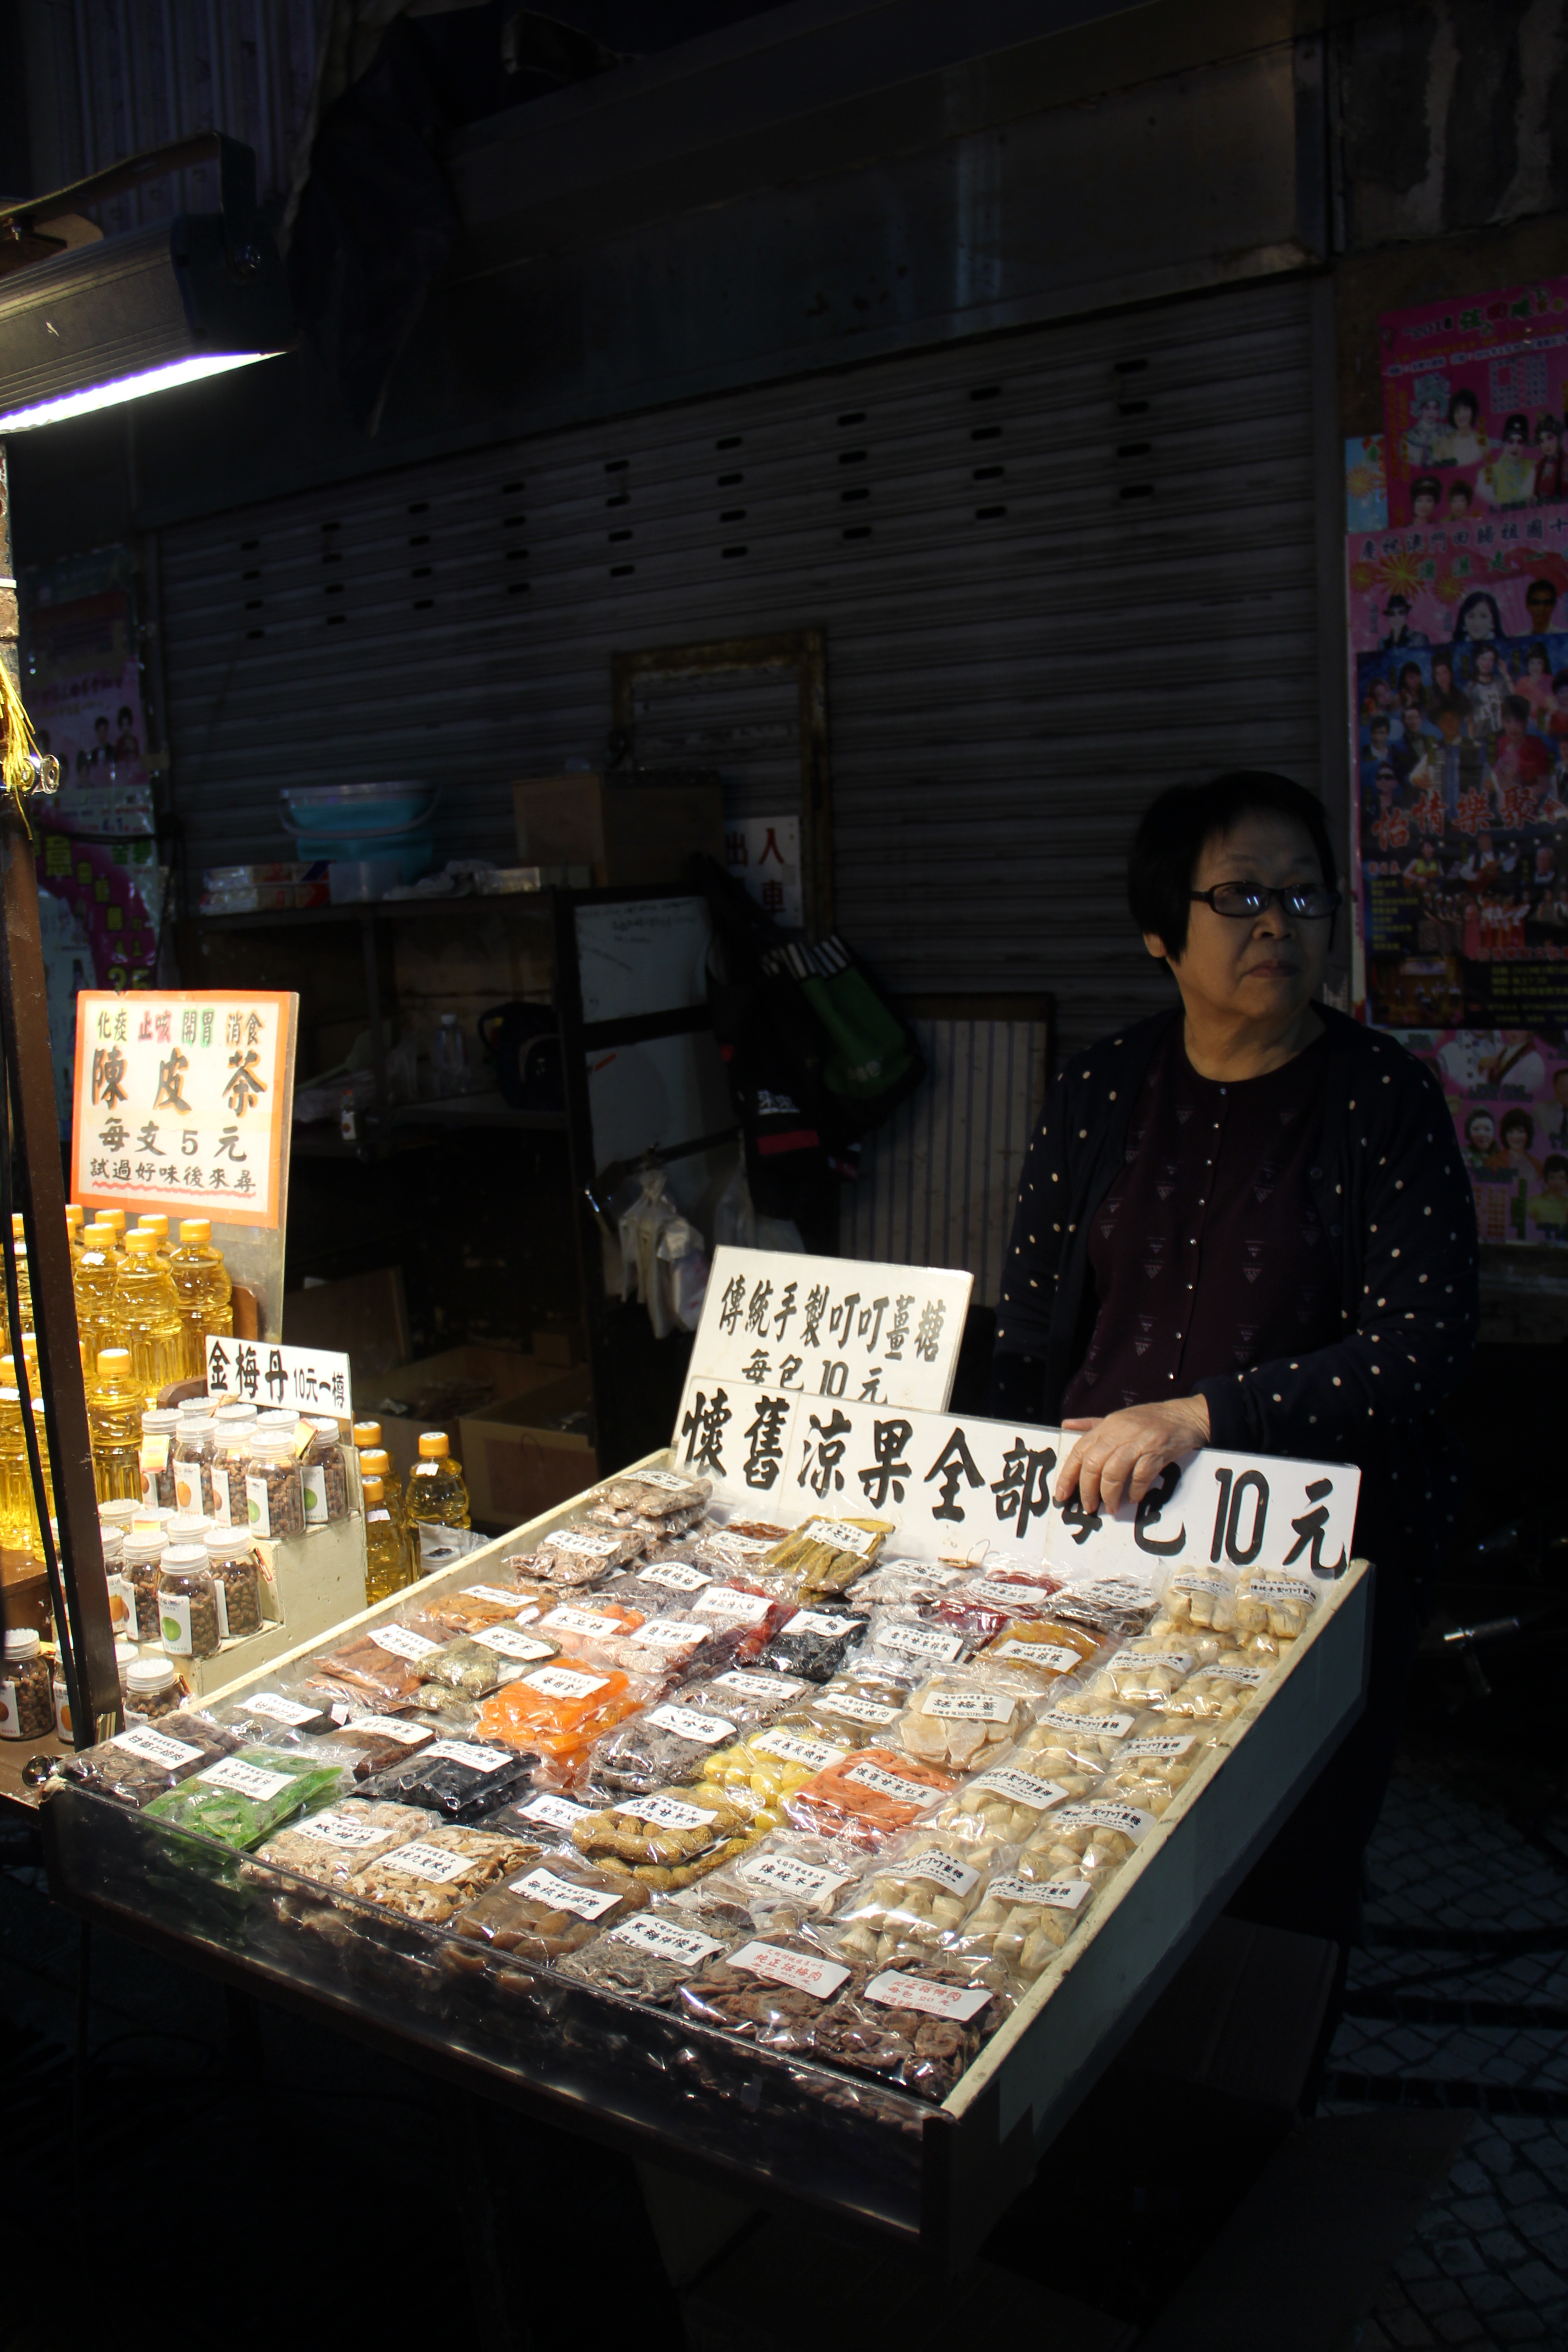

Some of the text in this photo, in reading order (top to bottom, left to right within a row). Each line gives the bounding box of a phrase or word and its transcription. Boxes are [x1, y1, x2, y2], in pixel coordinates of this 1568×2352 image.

[761, 878, 785, 916] 車
[97, 1009, 263, 1046] 化痰 止咳 開胃 消食
[92, 1046, 268, 1117] 陳皮茶
[98, 1117, 247, 1162] 每支5元
[91, 1158, 256, 1193] 試過好味後來尋
[719, 1274, 946, 1362] 傳統手製叮叮薑糖
[207, 1341, 288, 1404] 金梅丹
[741, 1348, 888, 1405] 每包10元
